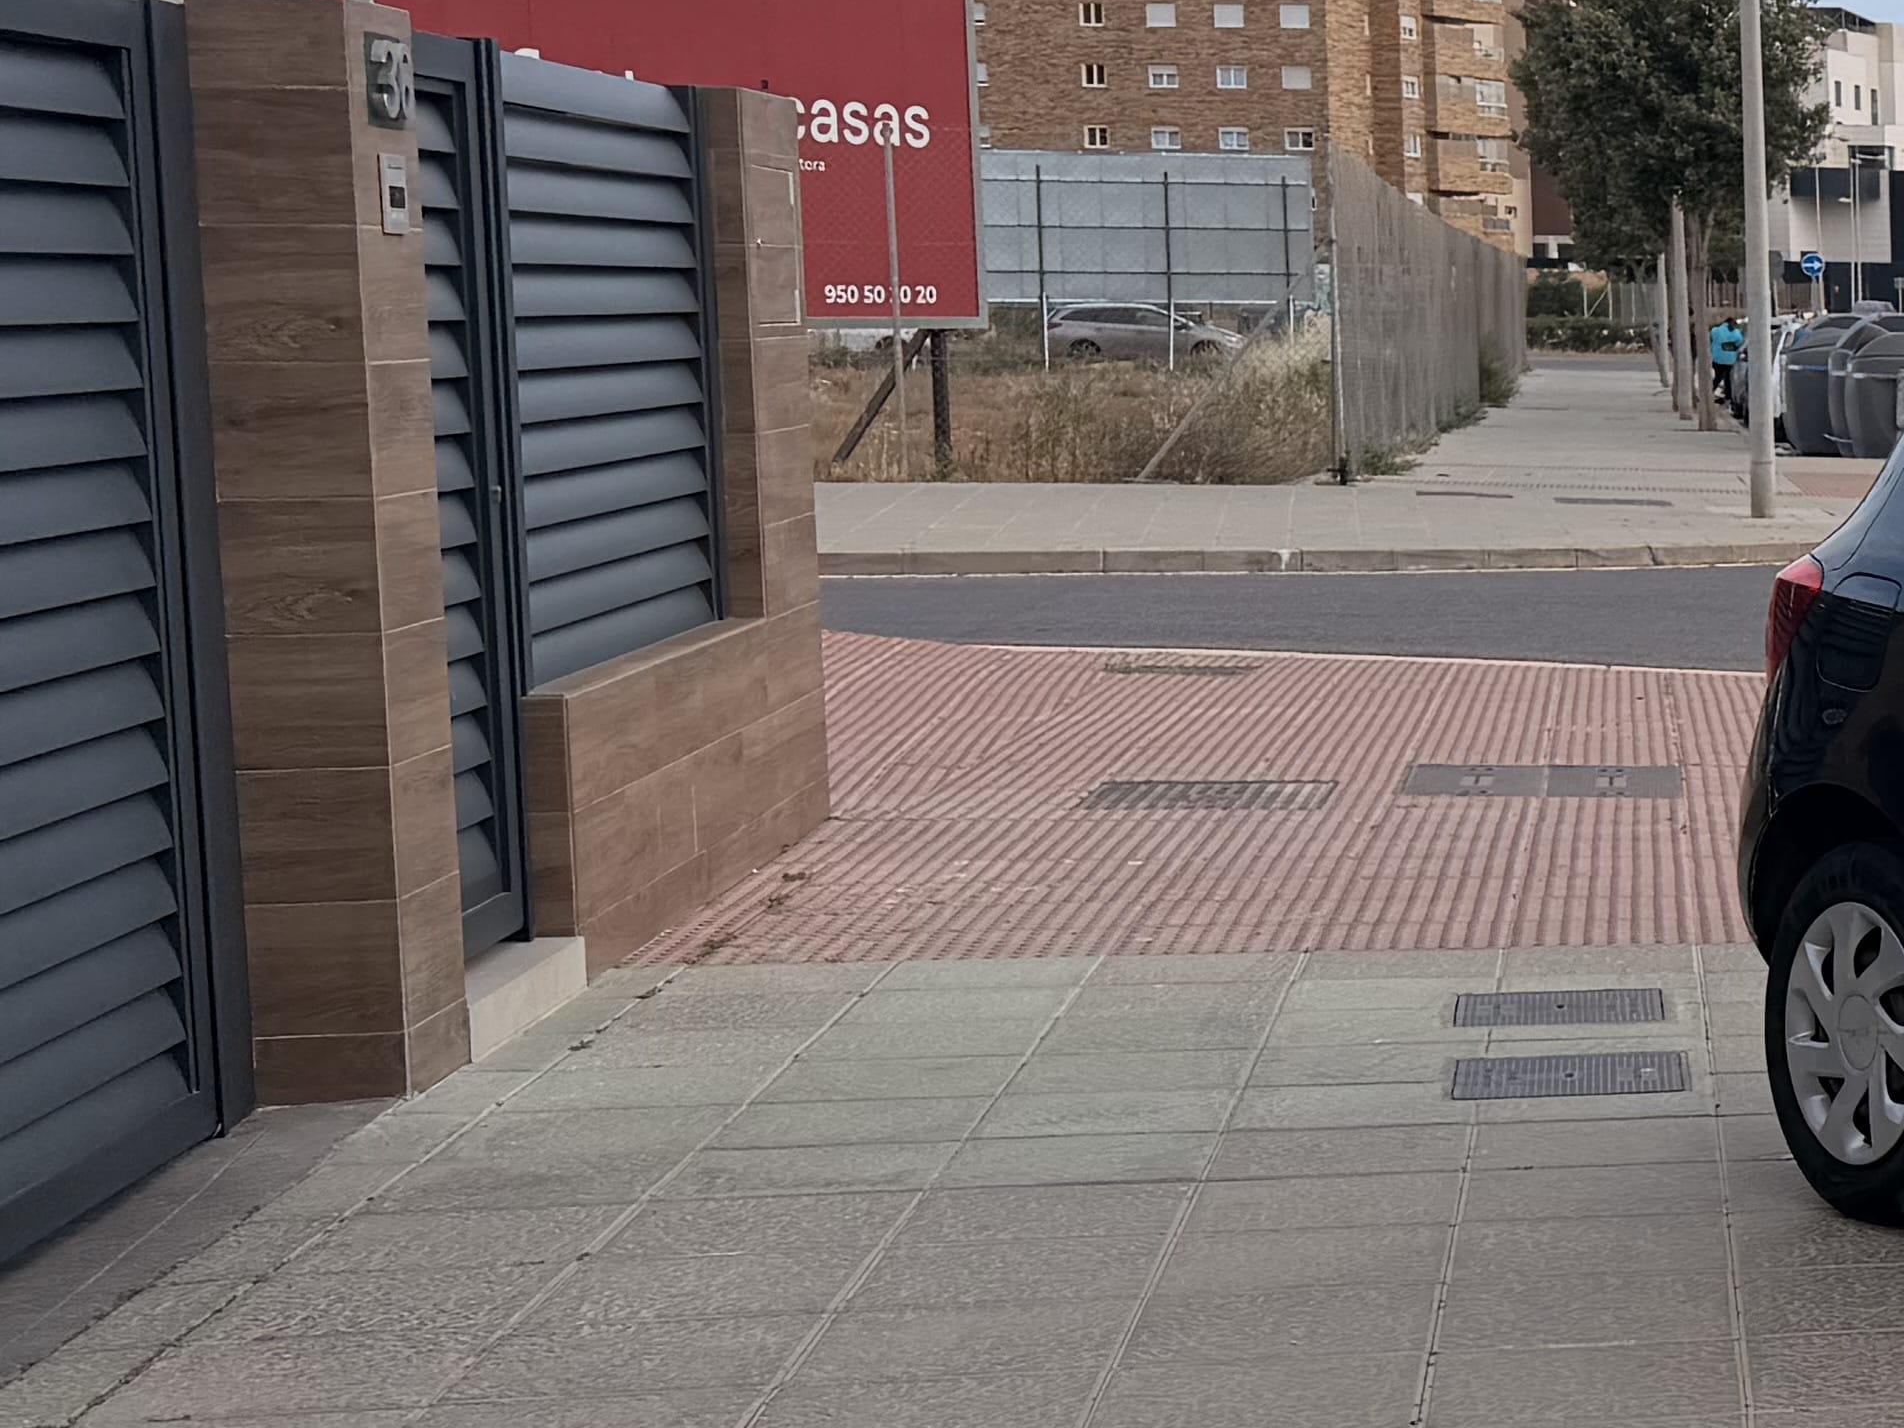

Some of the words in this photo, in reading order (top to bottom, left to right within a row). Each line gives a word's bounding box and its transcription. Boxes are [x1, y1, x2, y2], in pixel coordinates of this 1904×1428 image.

[824, 284, 859, 304] 950
[863, 285, 885, 304] 50
[915, 285, 937, 304] 20
